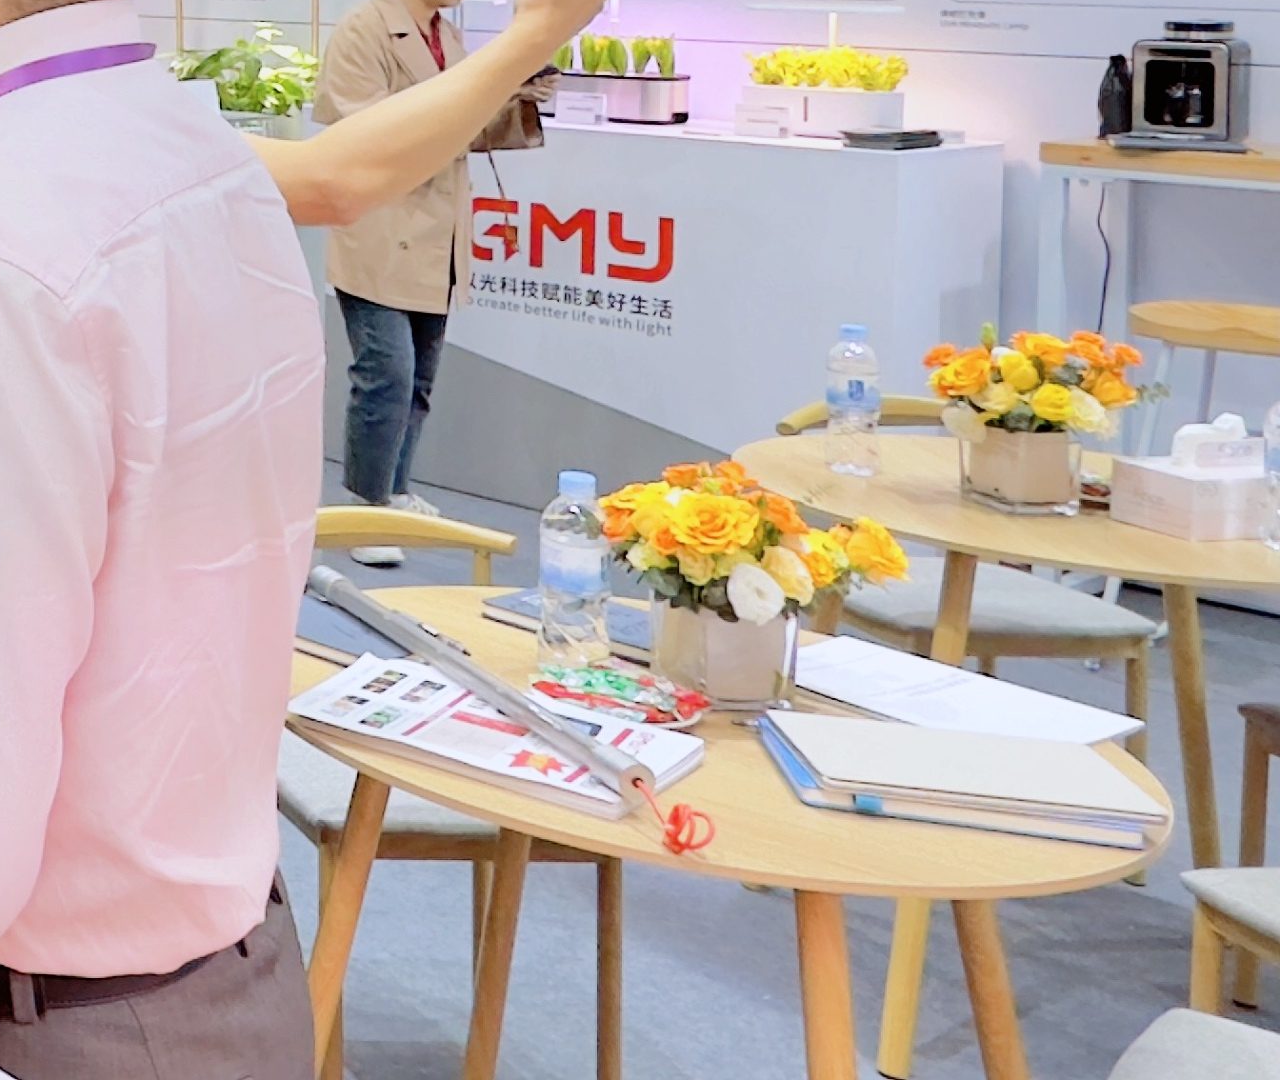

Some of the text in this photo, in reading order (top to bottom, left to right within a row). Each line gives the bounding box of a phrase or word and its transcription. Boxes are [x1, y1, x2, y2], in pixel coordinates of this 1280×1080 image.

[472, 197, 674, 283] GMY
[477, 297, 520, 313] create
[524, 302, 568, 321] better
[572, 309, 595, 325] life
[598, 314, 633, 331] with
[636, 319, 672, 337] light
